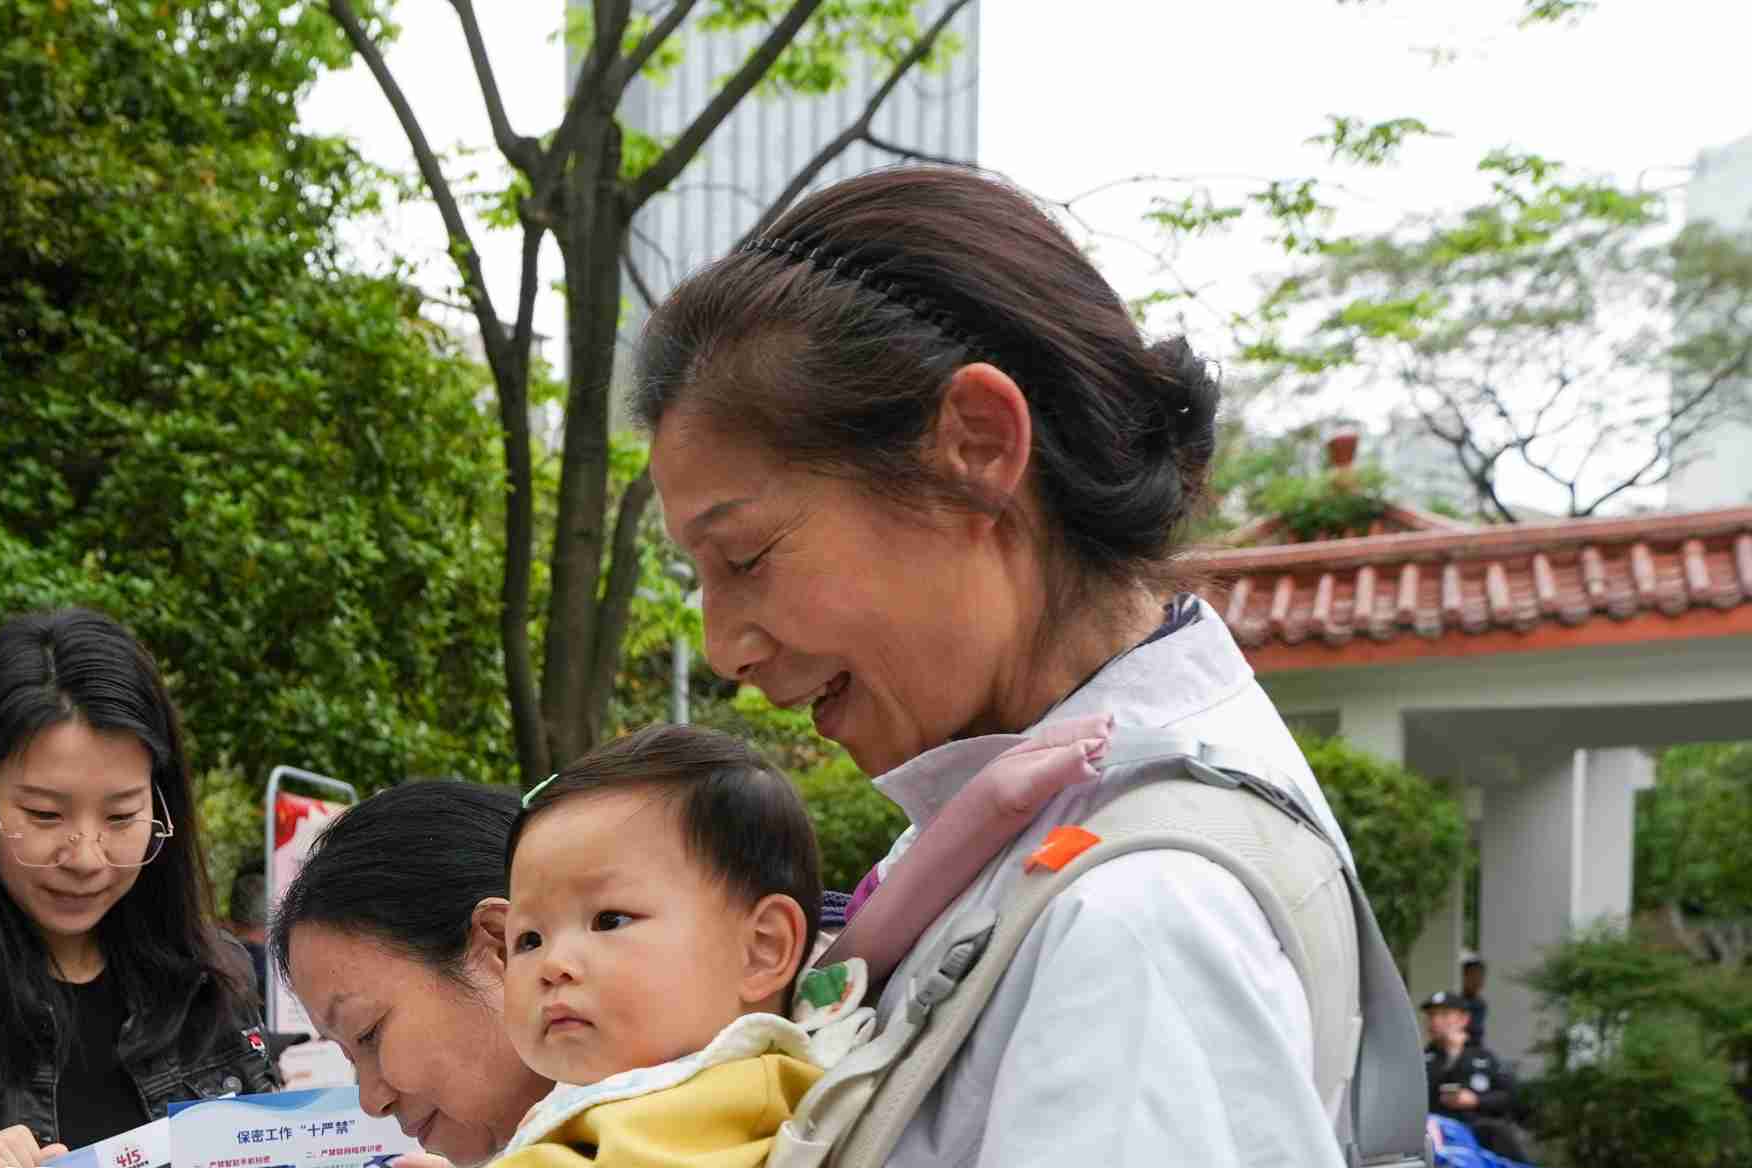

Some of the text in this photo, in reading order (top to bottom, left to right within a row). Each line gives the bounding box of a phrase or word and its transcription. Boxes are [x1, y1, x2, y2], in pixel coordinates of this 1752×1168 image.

[237, 1126, 293, 1145] 保密工作
[117, 1149, 141, 1167] 415
